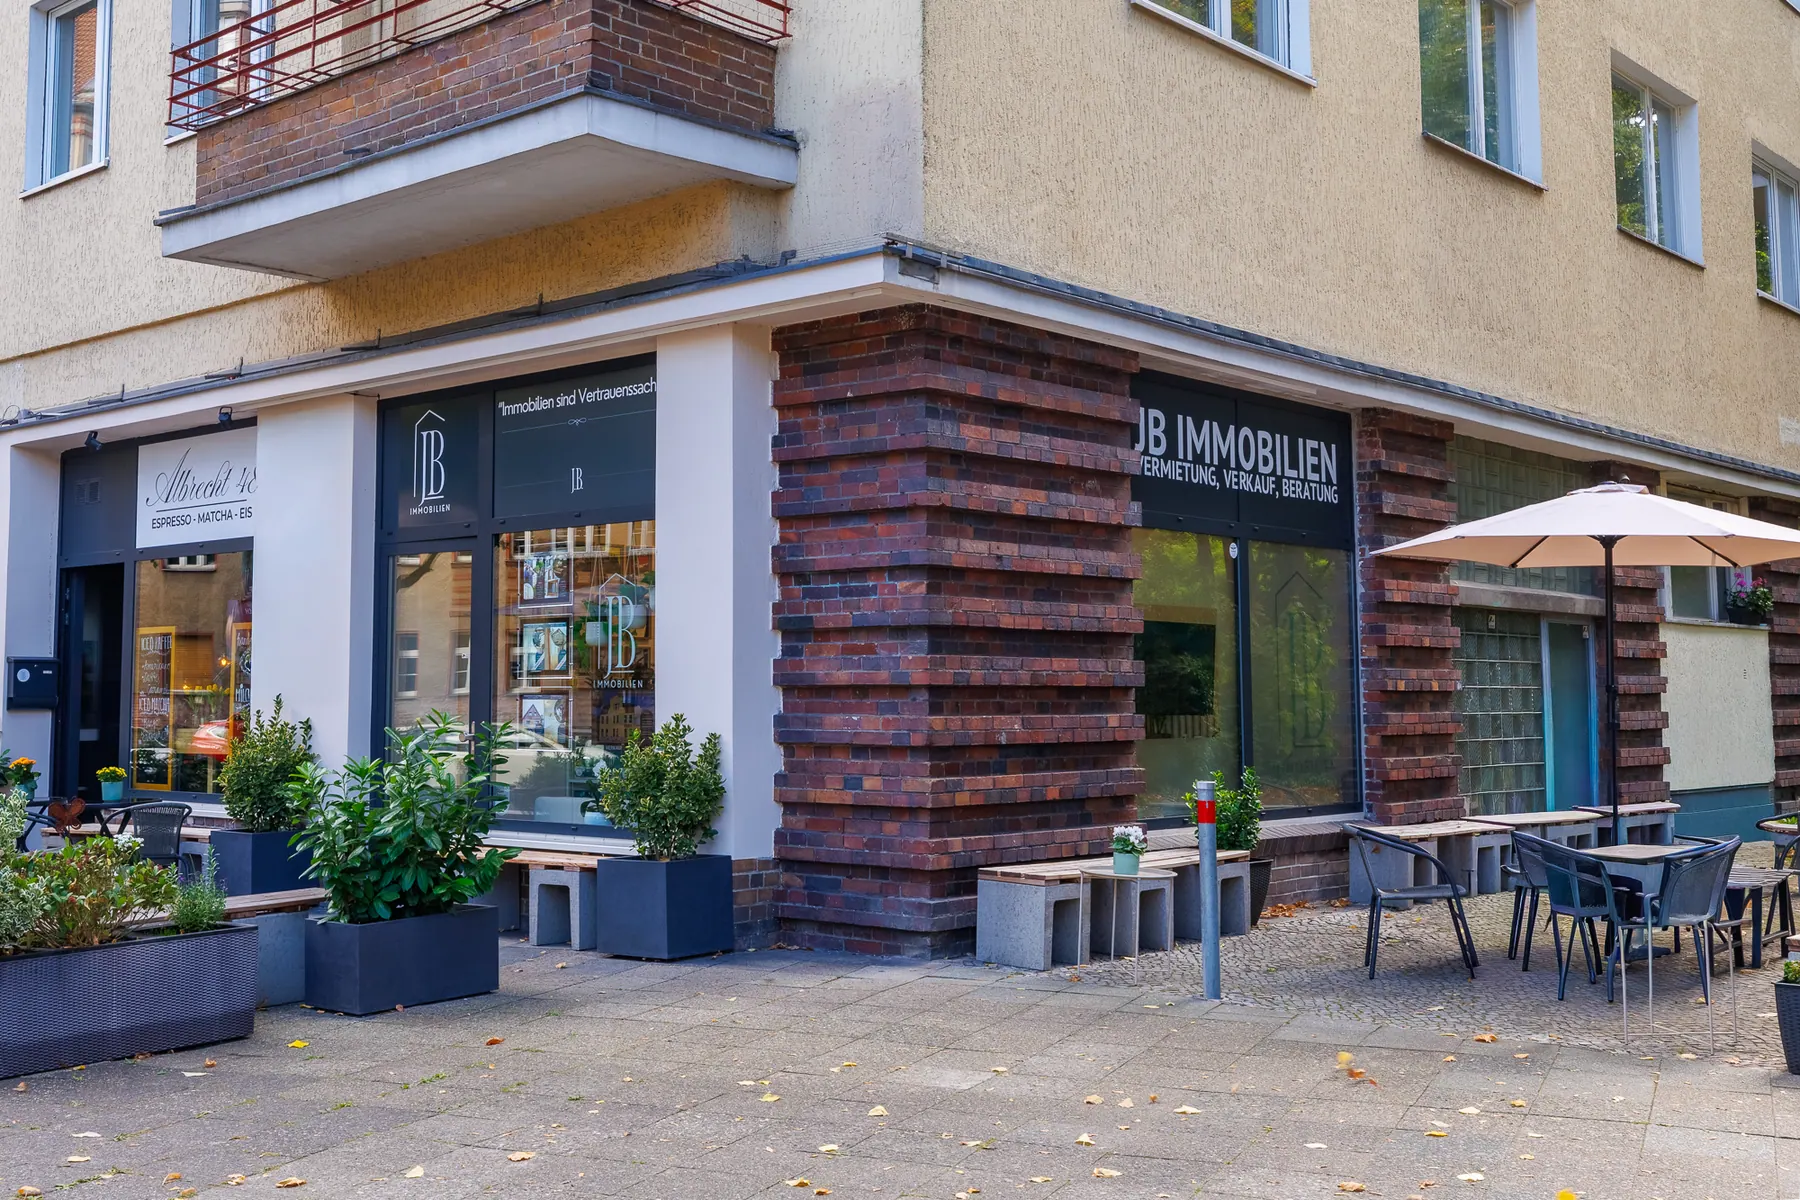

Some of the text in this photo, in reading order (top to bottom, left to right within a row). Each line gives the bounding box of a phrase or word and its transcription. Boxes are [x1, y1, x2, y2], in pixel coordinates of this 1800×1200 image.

[556, 389, 576, 408] sind
[1135, 406, 1337, 485] JB IMMOBILIEN
[146, 447, 233, 507] Albrecht
[1223, 469, 1279, 499] VERKAUF,
[1282, 478, 1338, 504] BERATUNG
[151, 514, 192, 529] ESPRESSO
[197, 509, 233, 524] MATCHA
[239, 507, 253, 519] EIS
[409, 503, 451, 516] IMMOBILIEN
[592, 679, 643, 689] IMMOBILIEN
